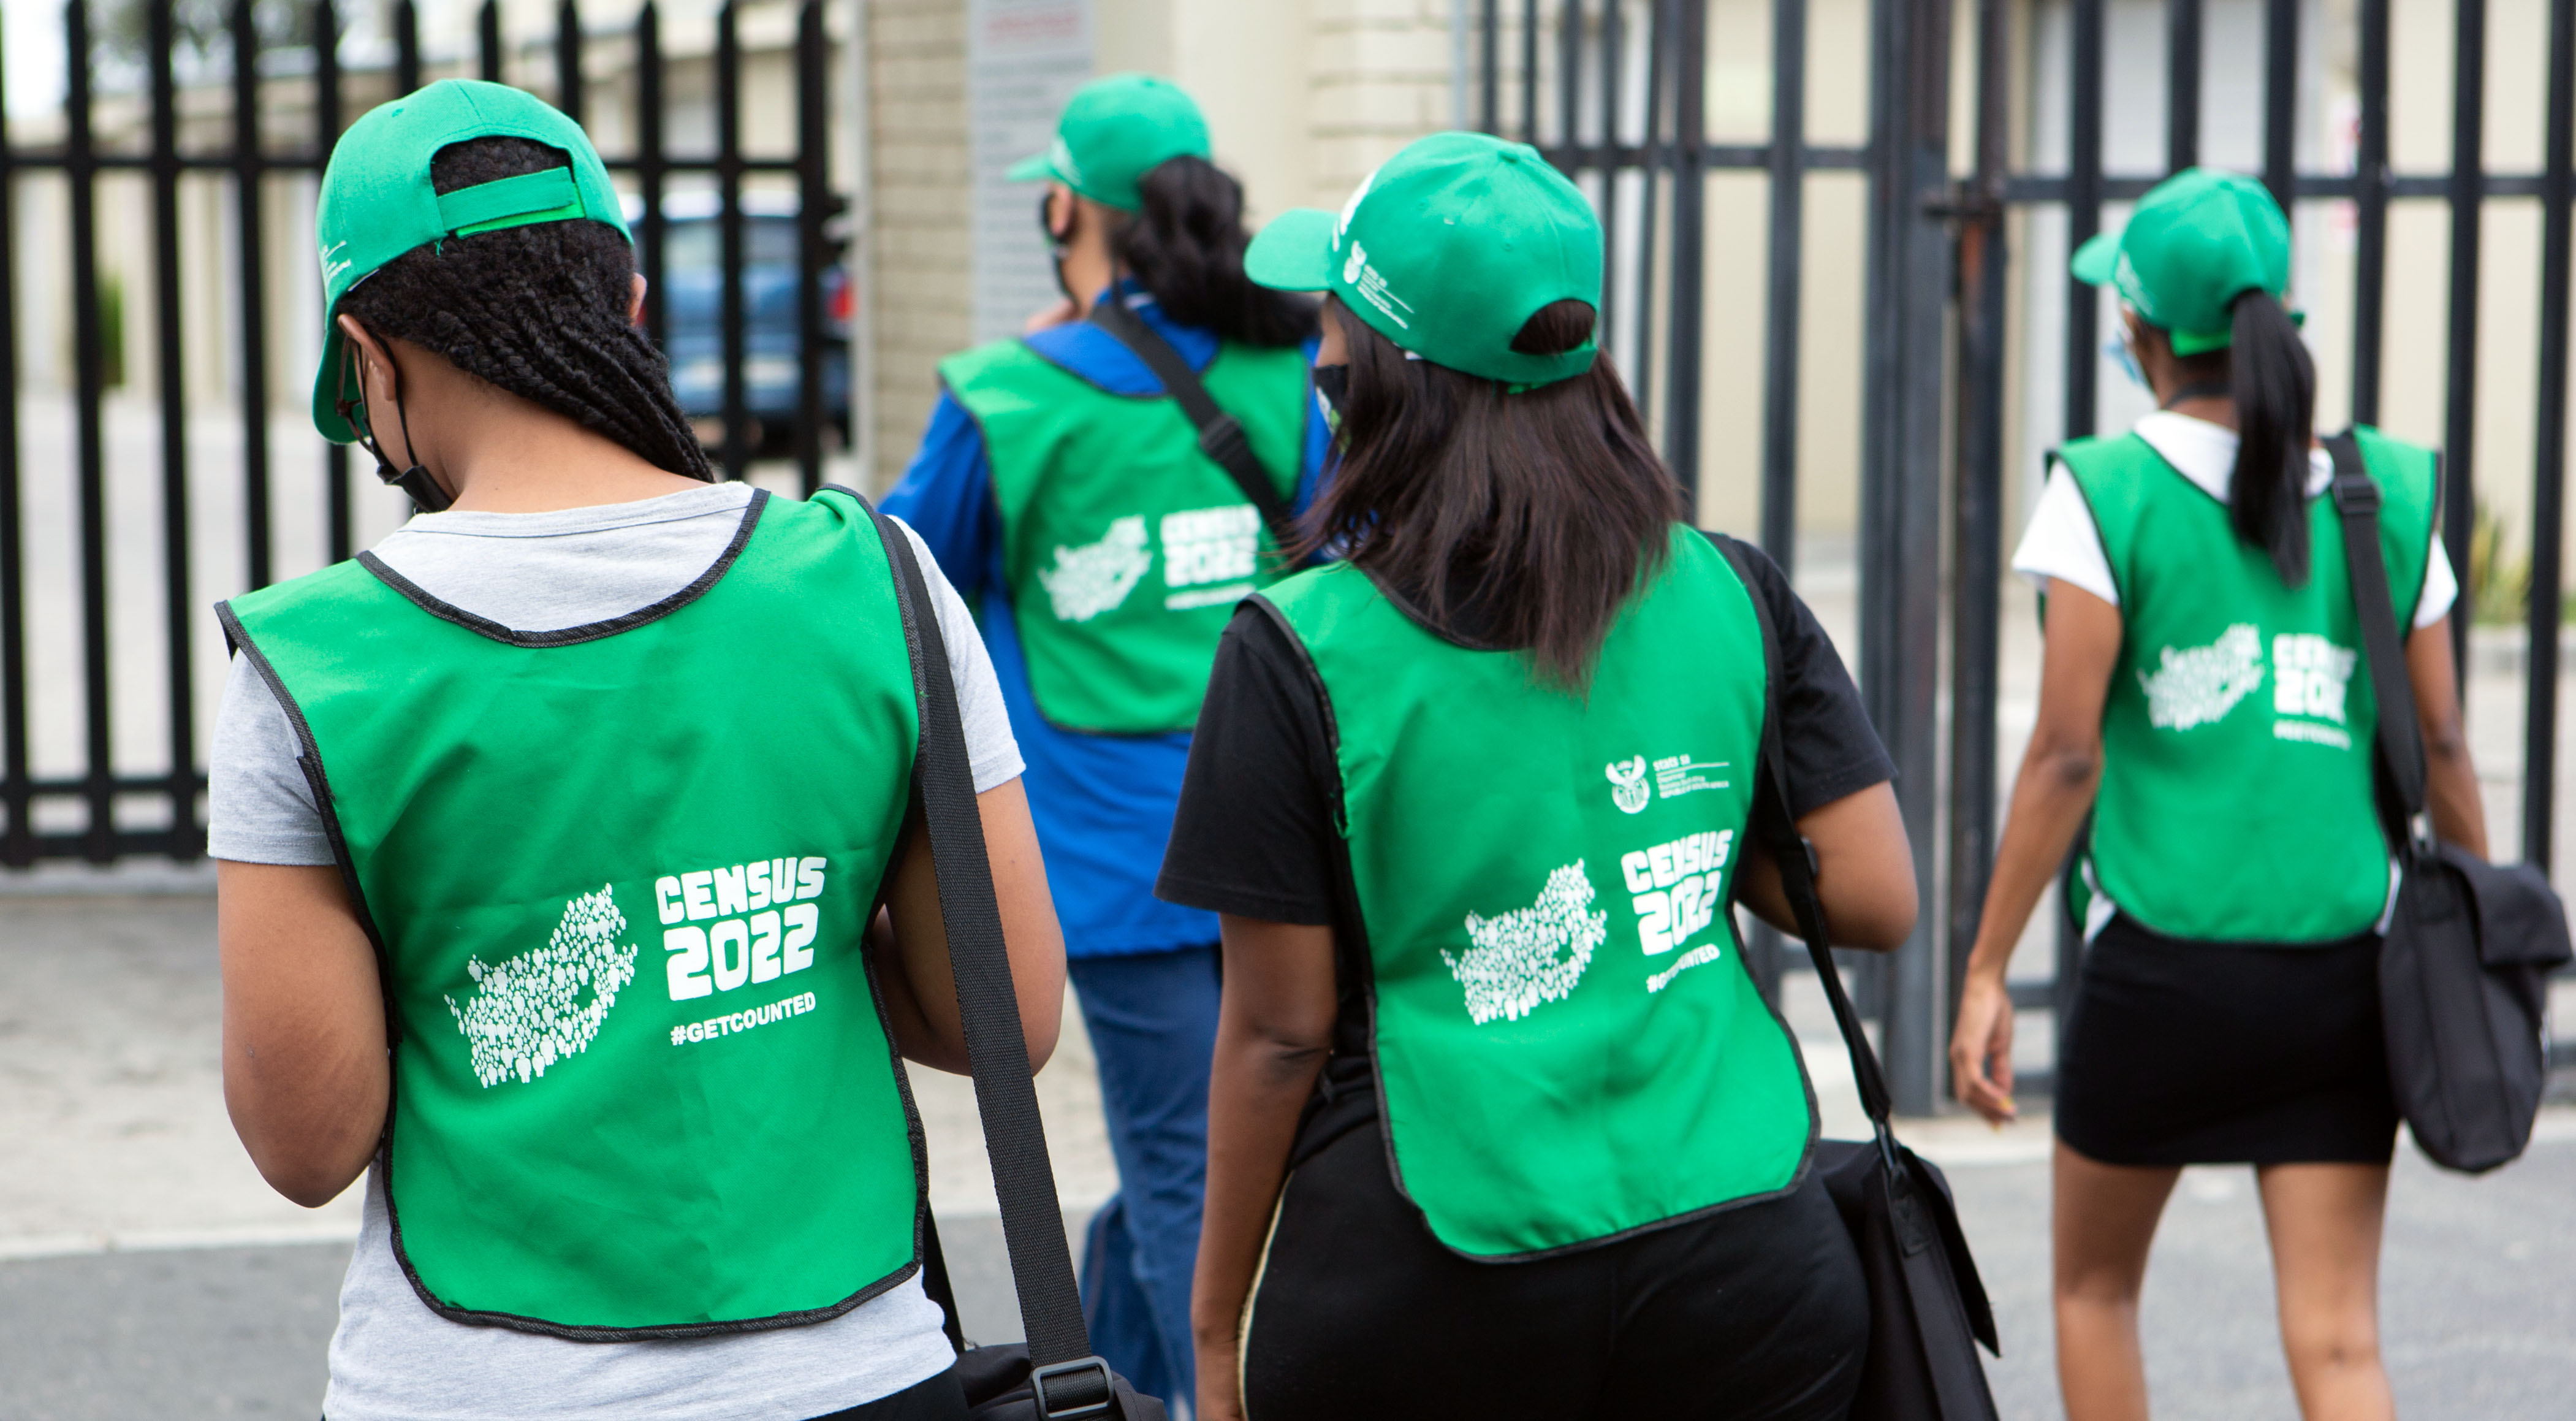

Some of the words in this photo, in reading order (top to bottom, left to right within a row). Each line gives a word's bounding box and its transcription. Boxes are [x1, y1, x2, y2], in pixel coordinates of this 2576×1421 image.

[655, 856, 827, 924] CENSUS
[1621, 829, 1733, 894] CENSUS
[1632, 870, 1722, 956] 2022
[663, 903, 819, 1001] 2022
[670, 991, 816, 1045] #GETCOUNTED
